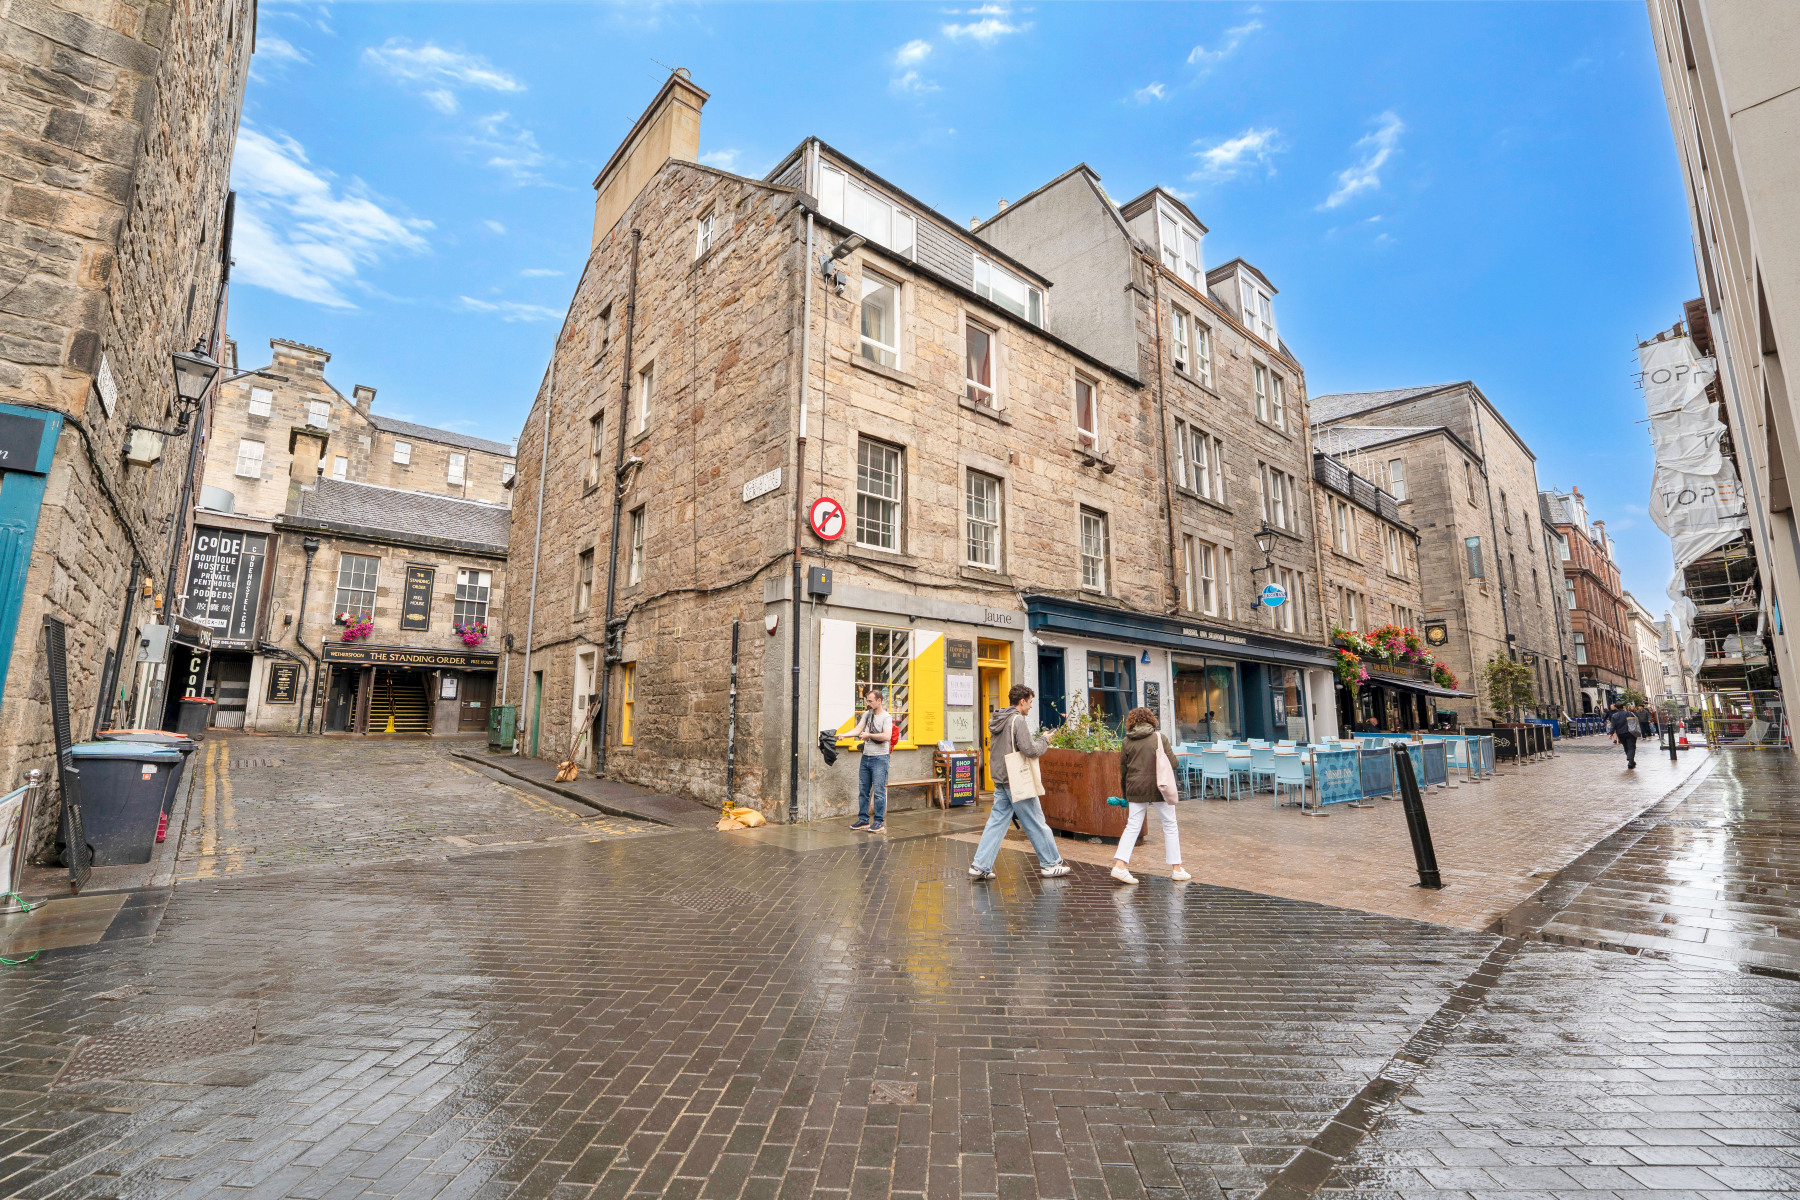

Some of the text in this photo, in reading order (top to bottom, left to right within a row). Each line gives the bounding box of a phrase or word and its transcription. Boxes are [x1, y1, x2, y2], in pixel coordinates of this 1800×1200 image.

[194, 553, 237, 565] BOUTIQUE
[197, 562, 230, 573] HOSTEL
[200, 573, 231, 582] PRIVATE
[193, 578, 237, 589] PENTHOUSE
[982, 608, 1013, 625] Jaune
[370, 653, 387, 661] THE
[389, 654, 435, 664] STANDING
[436, 656, 466, 665] ORDER
